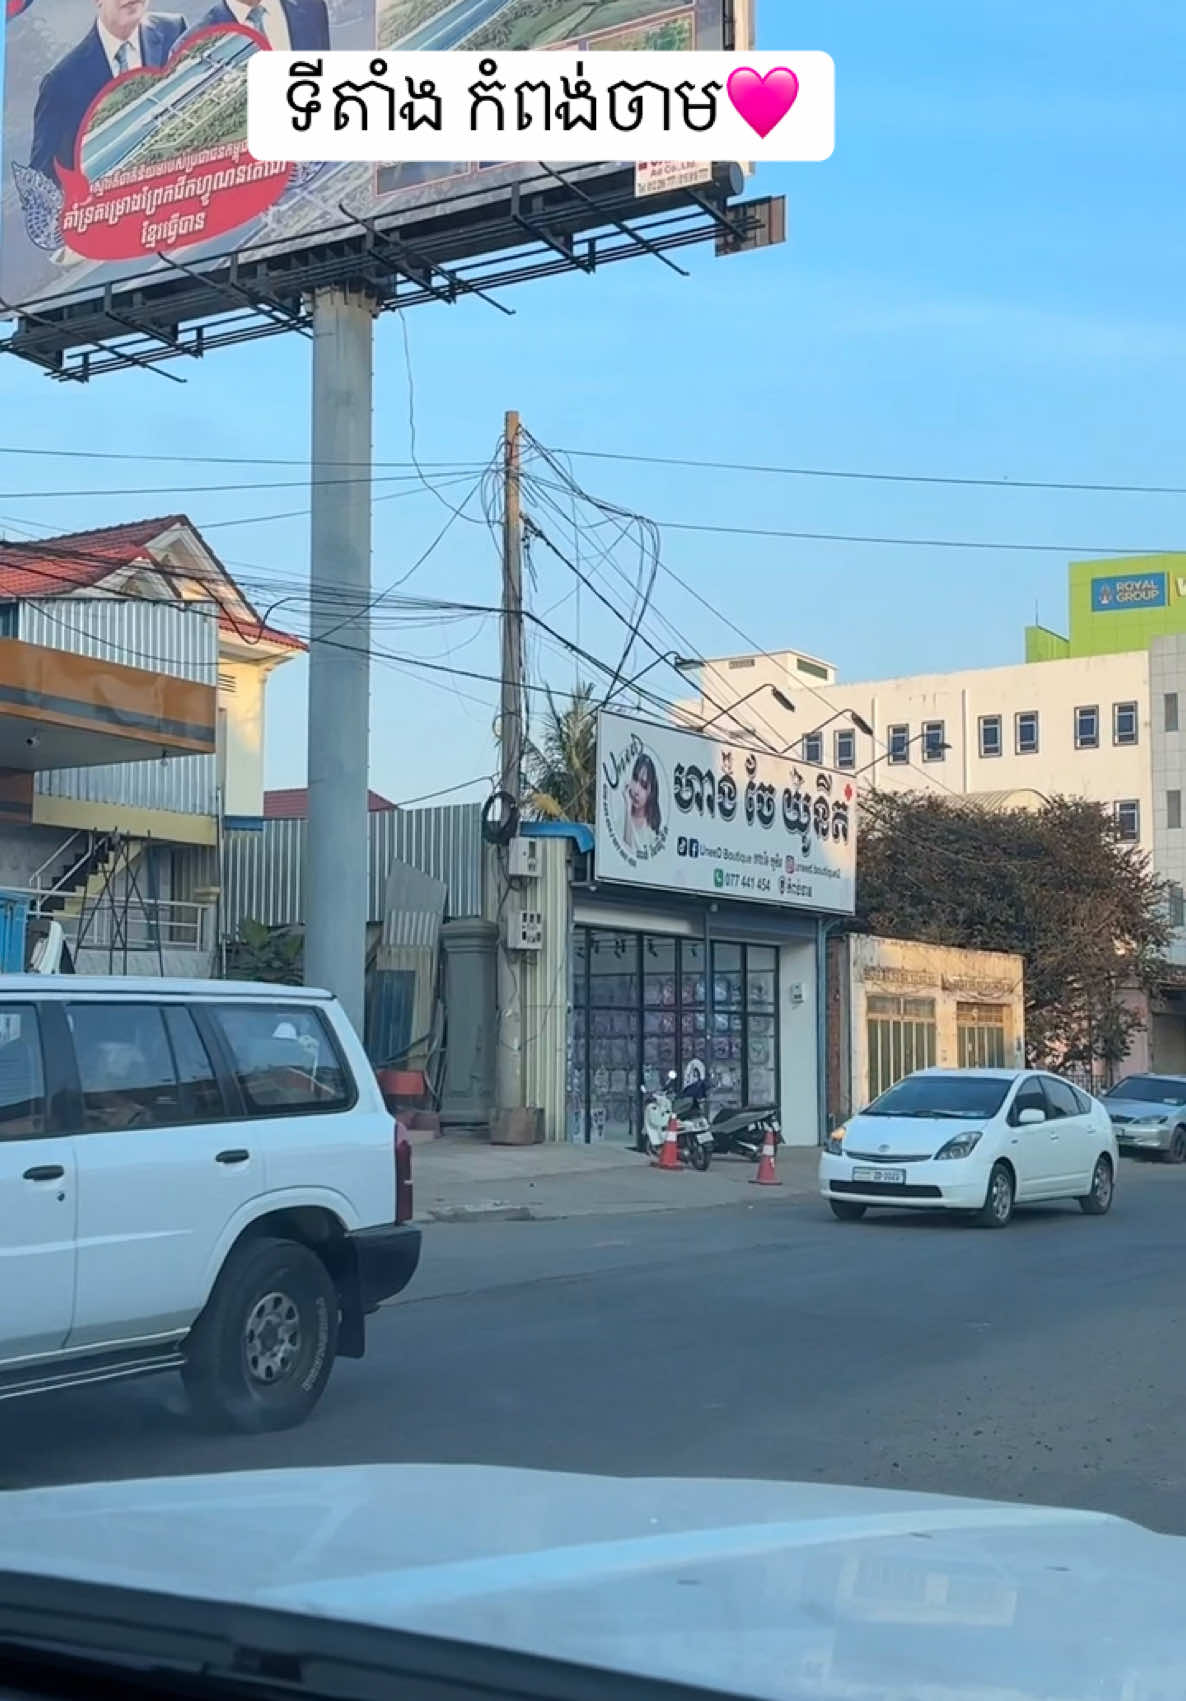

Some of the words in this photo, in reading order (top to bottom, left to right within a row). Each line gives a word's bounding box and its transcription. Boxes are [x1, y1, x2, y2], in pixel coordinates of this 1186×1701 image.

[1116, 579, 1160, 592] ROYAL
[1116, 590, 1160, 603] GROUP
[725, 872, 740, 887] 077
[741, 874, 756, 889] 441
[757, 877, 771, 892] 454
